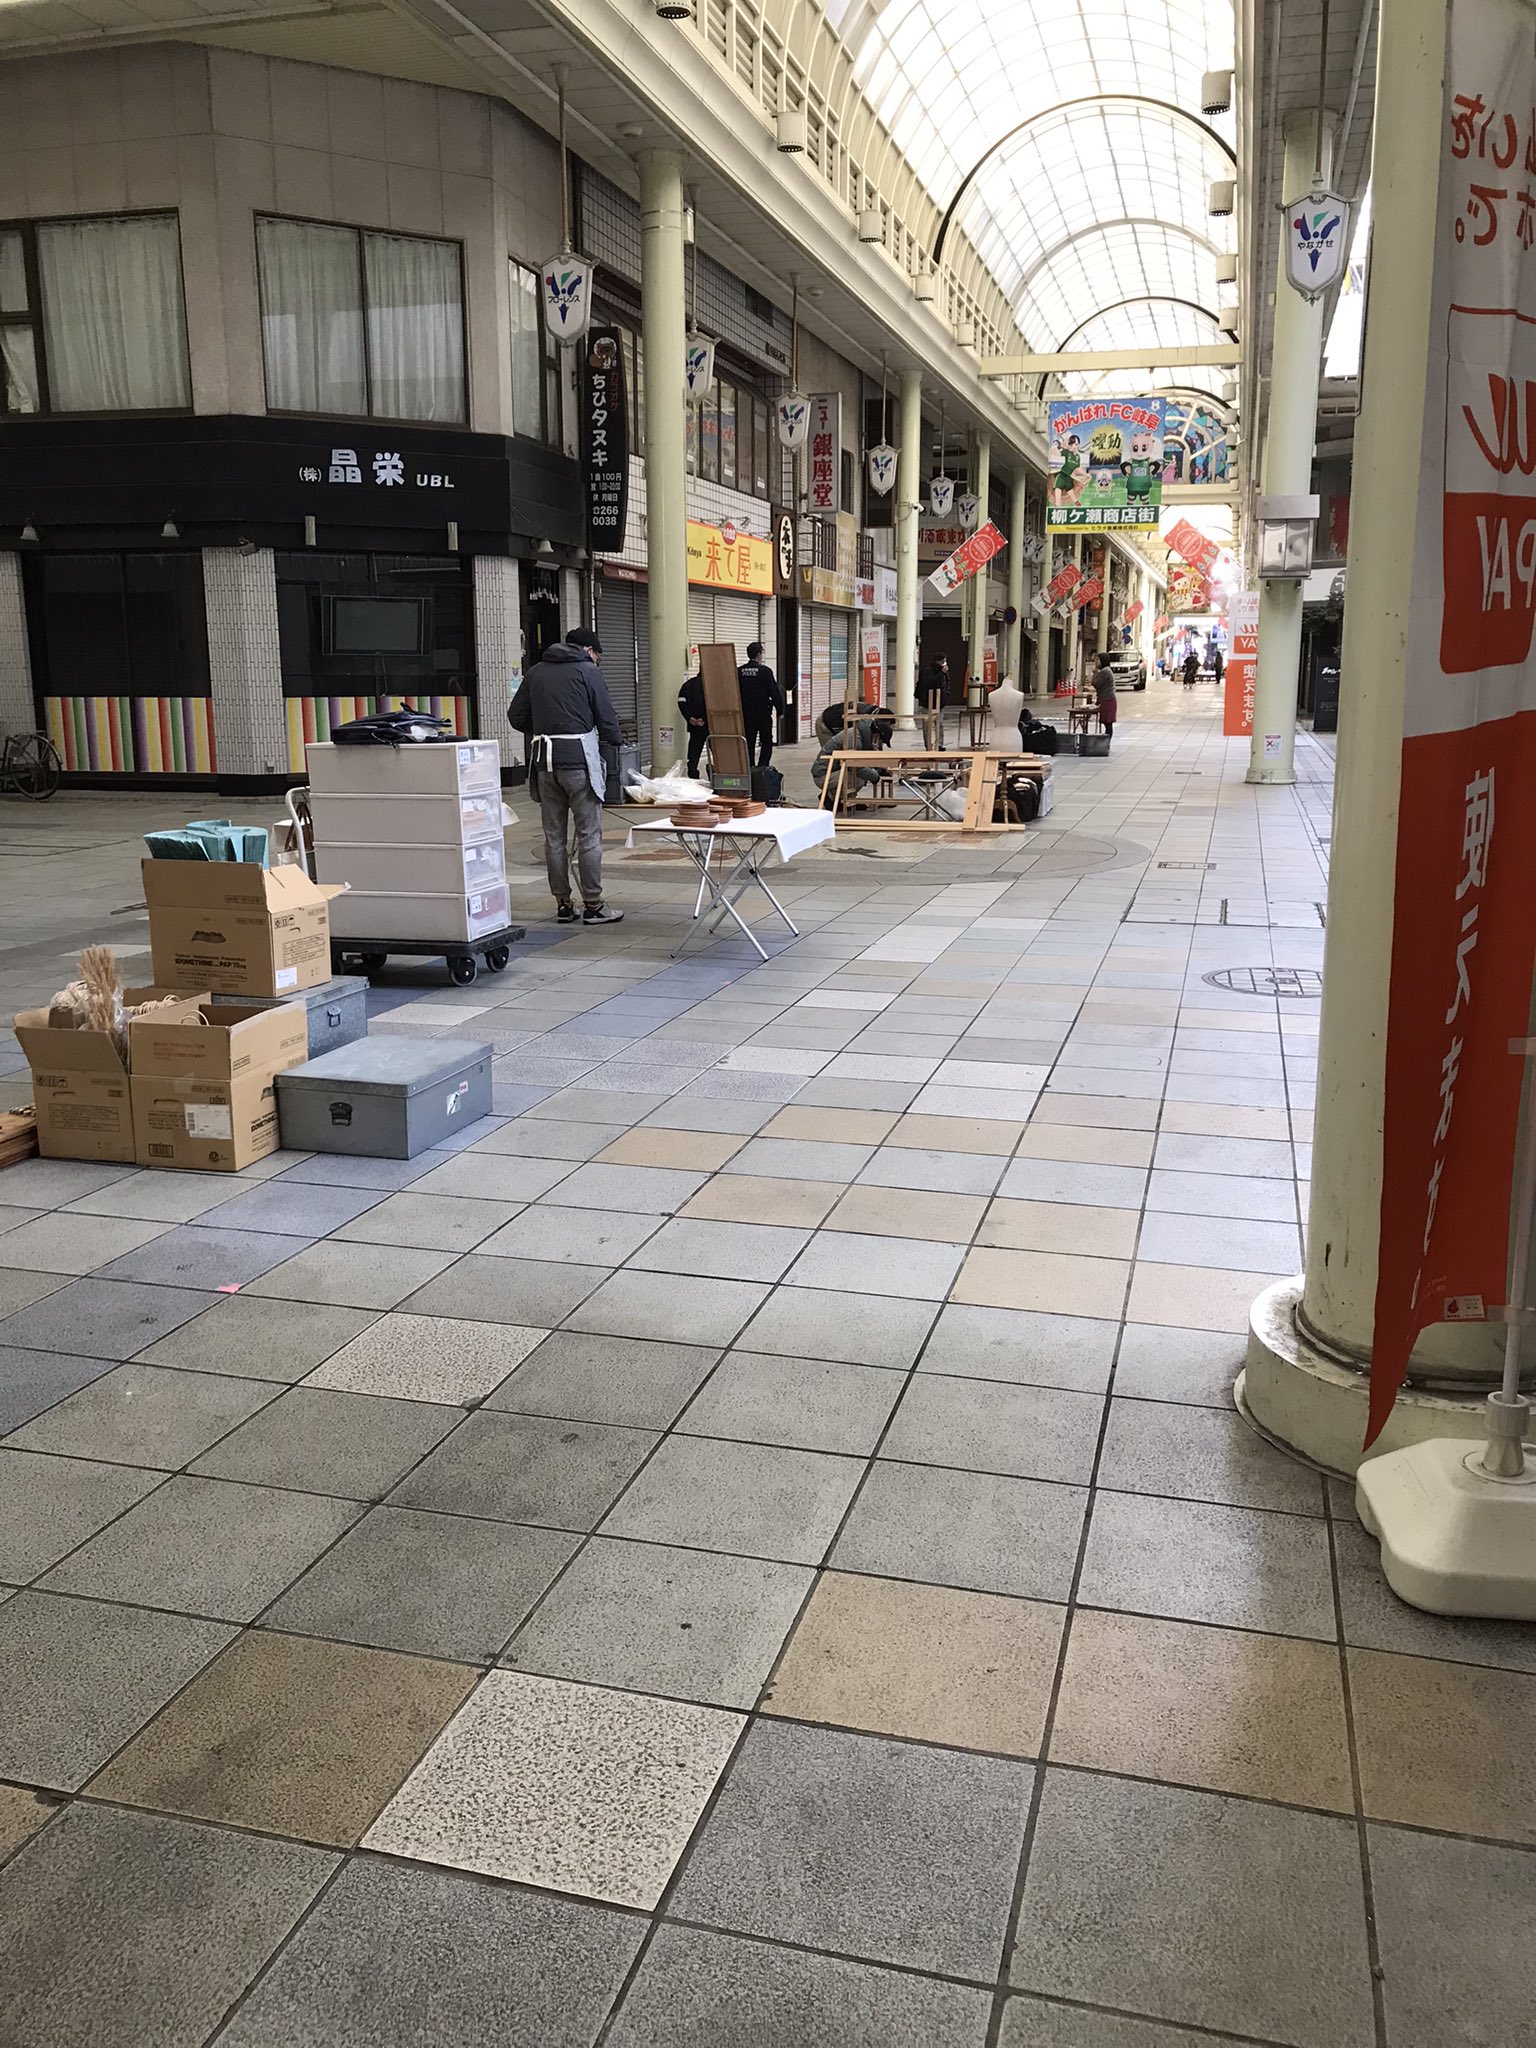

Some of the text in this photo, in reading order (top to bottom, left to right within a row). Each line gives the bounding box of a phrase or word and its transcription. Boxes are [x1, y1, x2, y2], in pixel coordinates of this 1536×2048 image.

[1297, 239, 1334, 249] やながせ
[547, 295, 580, 304] フローレンス
[591, 373, 609, 467] ちびタヌキ
[416, 474, 455, 488] UBL
[600, 505, 619, 515] 266
[592, 516, 617, 526] 0038
[705, 536, 751, 585] 来て屋
